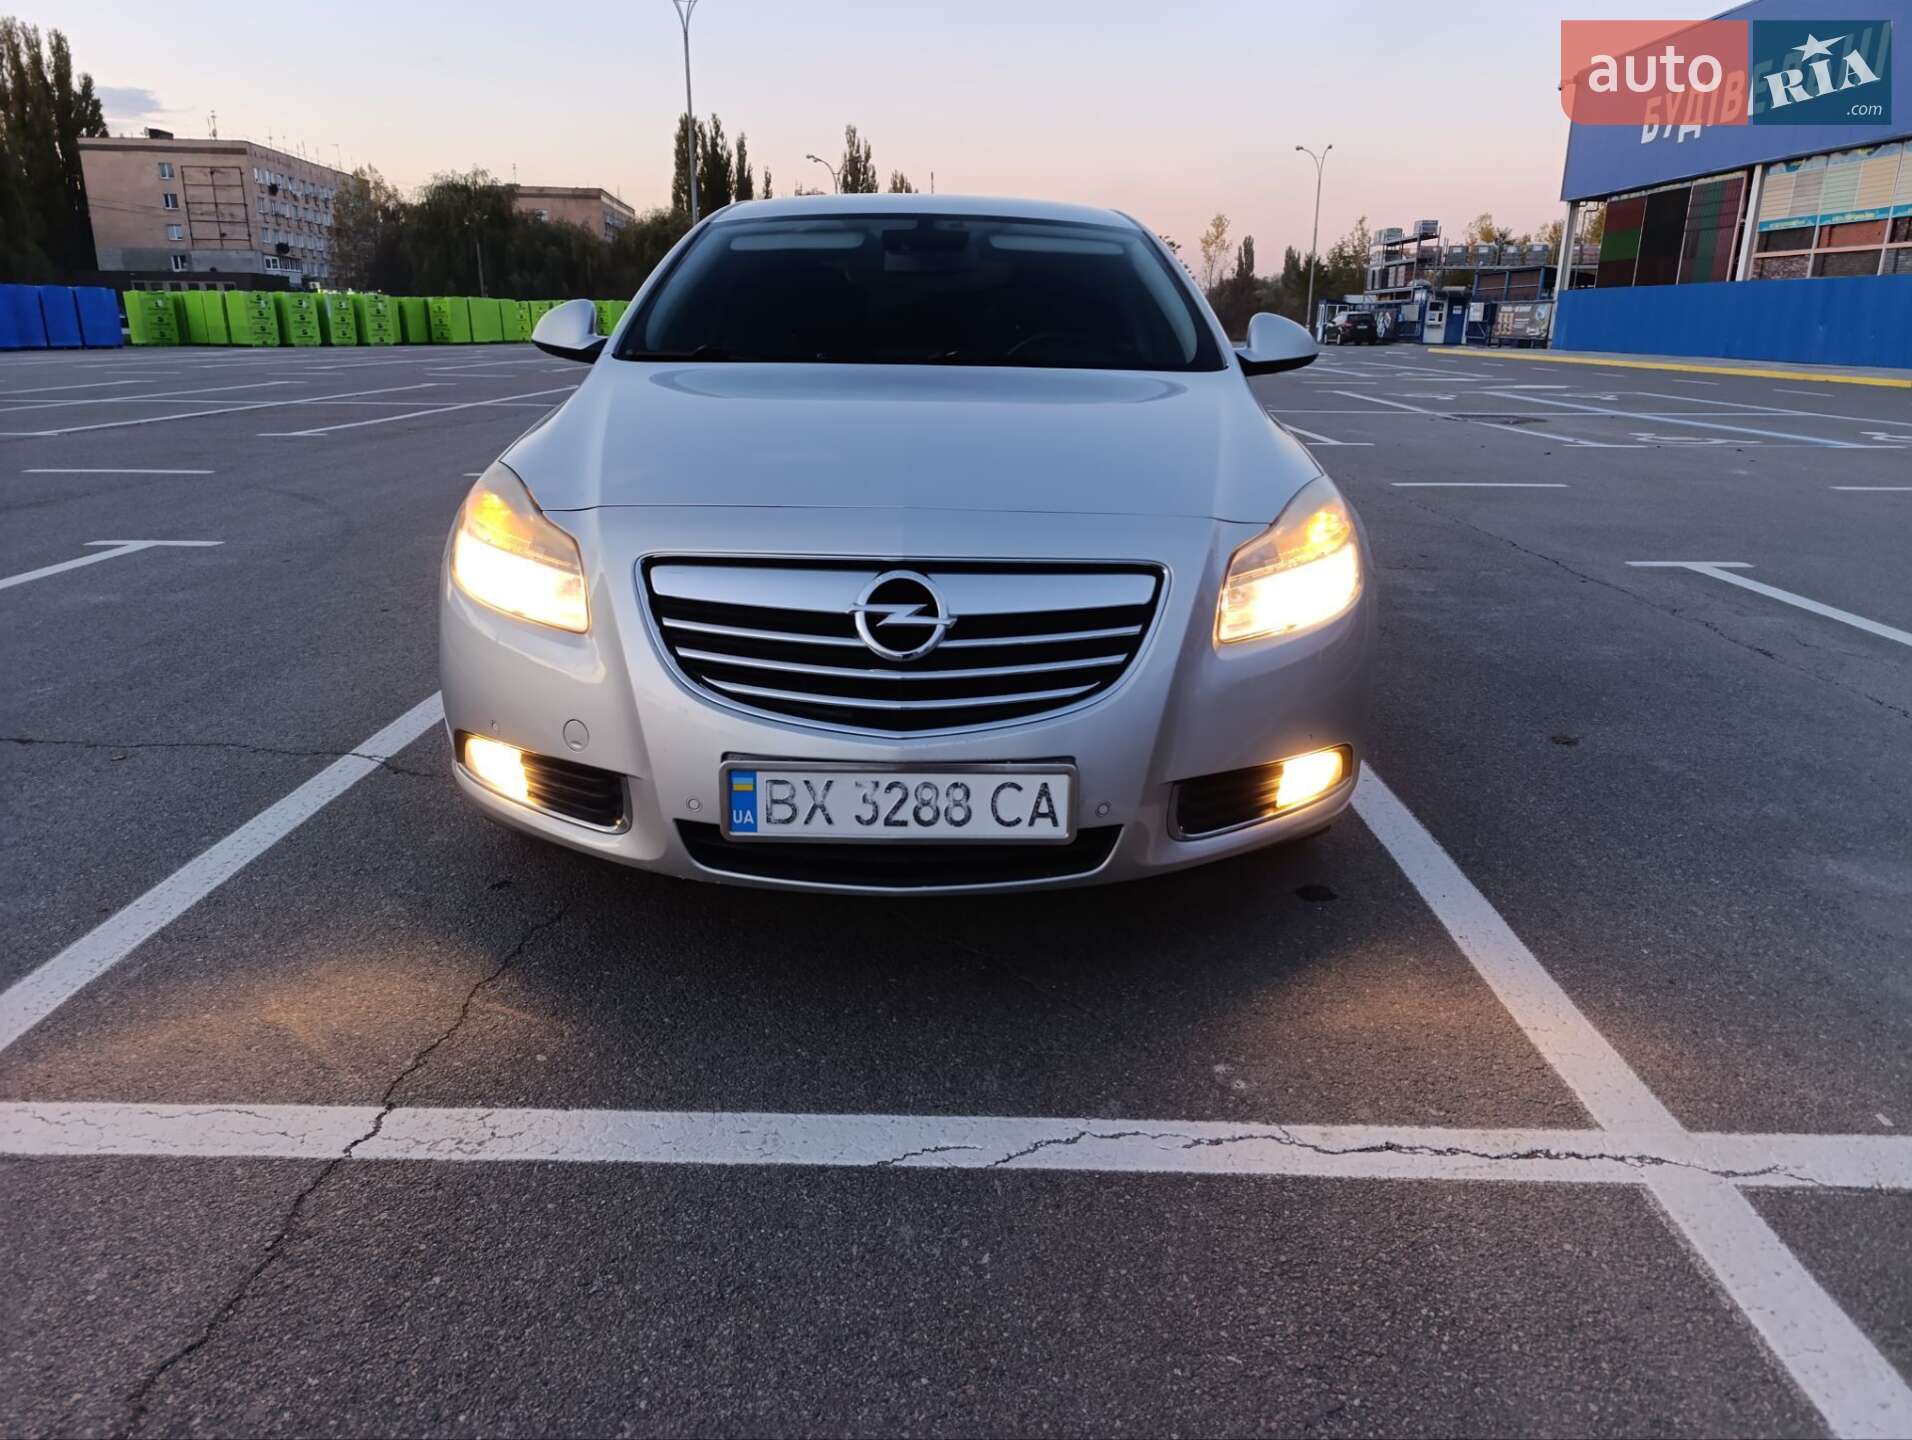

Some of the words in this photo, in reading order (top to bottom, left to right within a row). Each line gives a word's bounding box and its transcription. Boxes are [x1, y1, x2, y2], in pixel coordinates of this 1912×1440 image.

[733, 809, 754, 824] UA
[765, 779, 834, 826] BX
[855, 780, 972, 828] 3288
[991, 782, 1059, 828] CA
